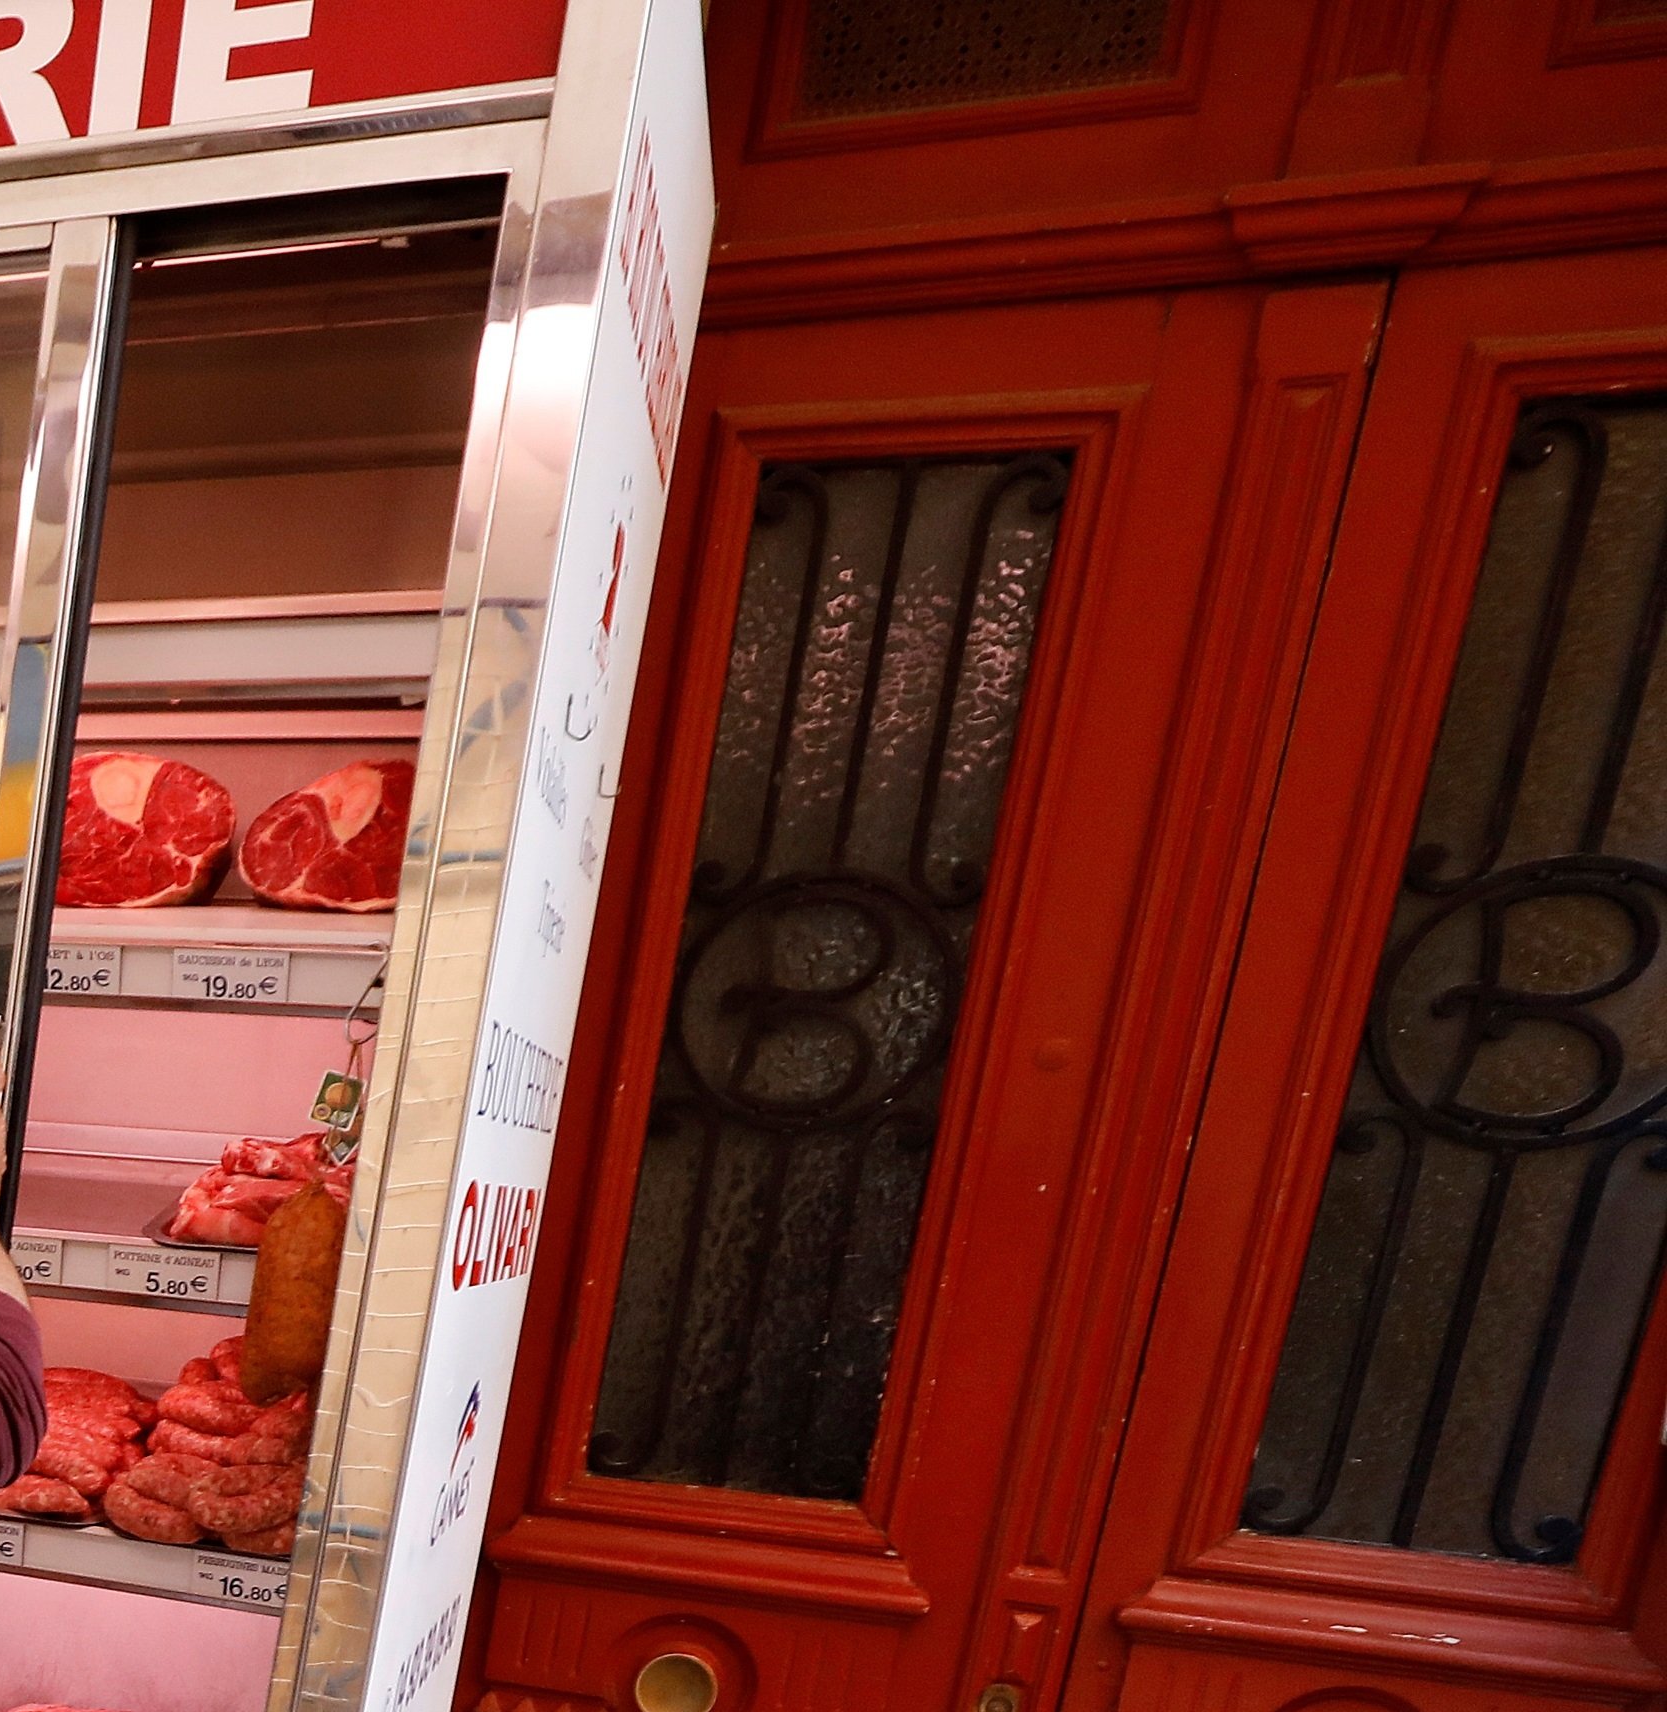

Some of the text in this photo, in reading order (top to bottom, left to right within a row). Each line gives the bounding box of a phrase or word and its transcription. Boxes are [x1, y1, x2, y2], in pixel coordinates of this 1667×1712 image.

[201, 975, 279, 999] 19.80€
[476, 1019, 565, 1135] BOUCHERIE
[452, 1178, 544, 1292] OLIVARI
[113, 1250, 162, 1263] POITRINE
[145, 1271, 209, 1296] 5.80€
[219, 1576, 288, 1602] 16.80€
